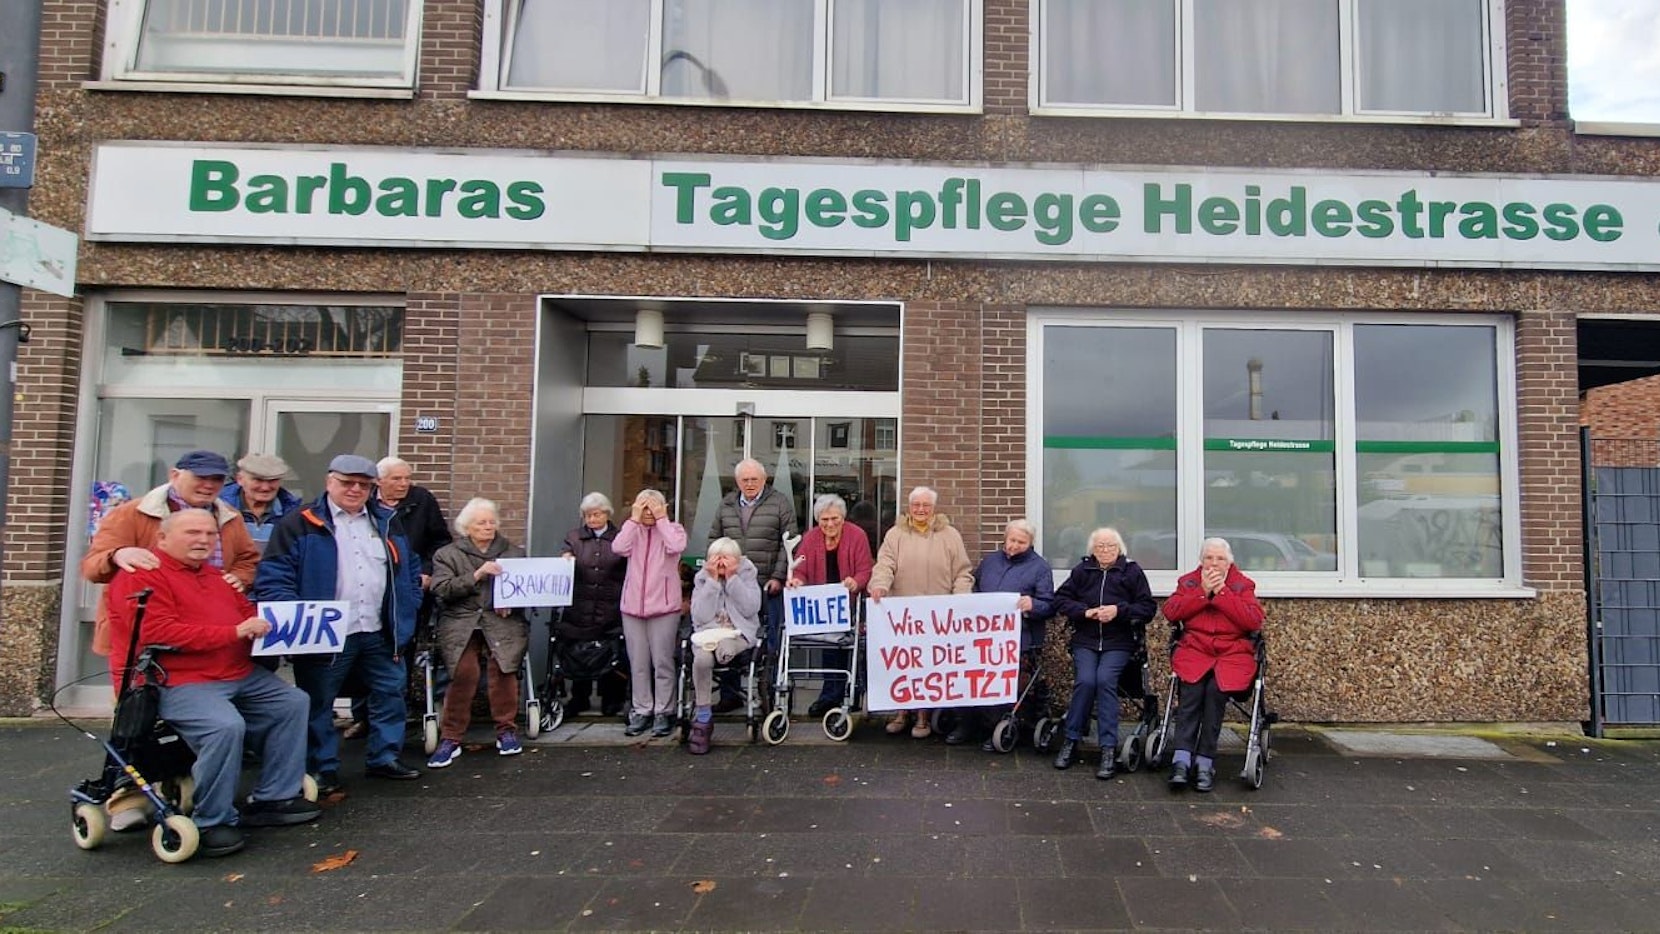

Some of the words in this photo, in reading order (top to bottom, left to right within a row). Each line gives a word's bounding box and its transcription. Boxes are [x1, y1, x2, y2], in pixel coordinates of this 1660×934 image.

[188, 160, 546, 220] Barbaras
[662, 172, 1120, 243] Tagespflege
[1143, 183, 1625, 243] Heidestrasse
[1229, 439, 1267, 450] Tagespflege
[1268, 440, 1310, 449] Heidestrasse
[500, 570, 572, 600] BRAUCHEN
[880, 645, 923, 671] VOR
[889, 669, 1018, 703] GESETZT
